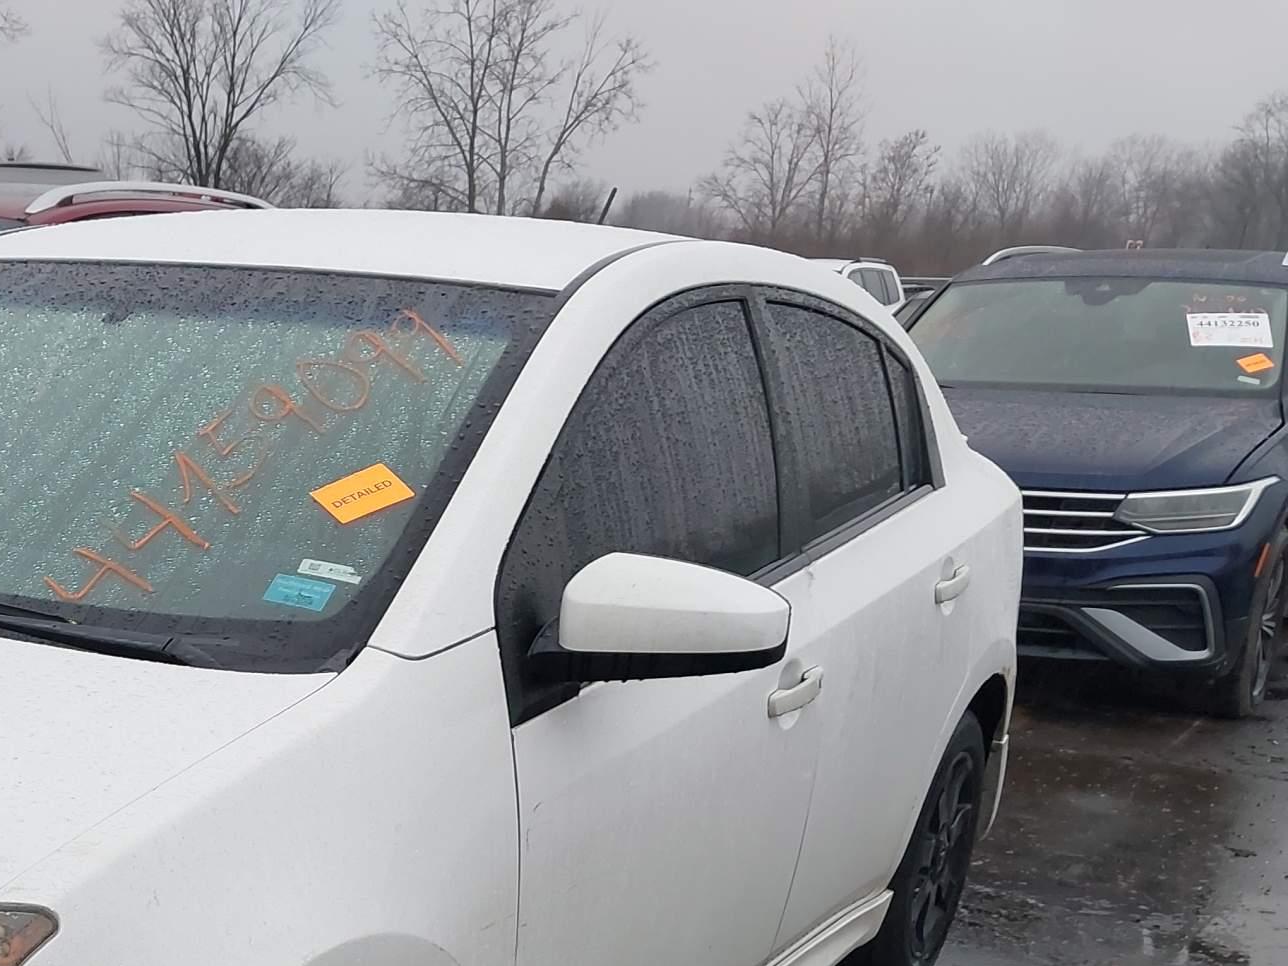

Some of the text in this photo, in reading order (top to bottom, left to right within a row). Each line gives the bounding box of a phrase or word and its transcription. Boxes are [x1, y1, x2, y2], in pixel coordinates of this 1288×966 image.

[1196, 319, 1261, 328] 44132250
[43, 308, 466, 601] 44159099
[331, 479, 392, 508] DETAILED
